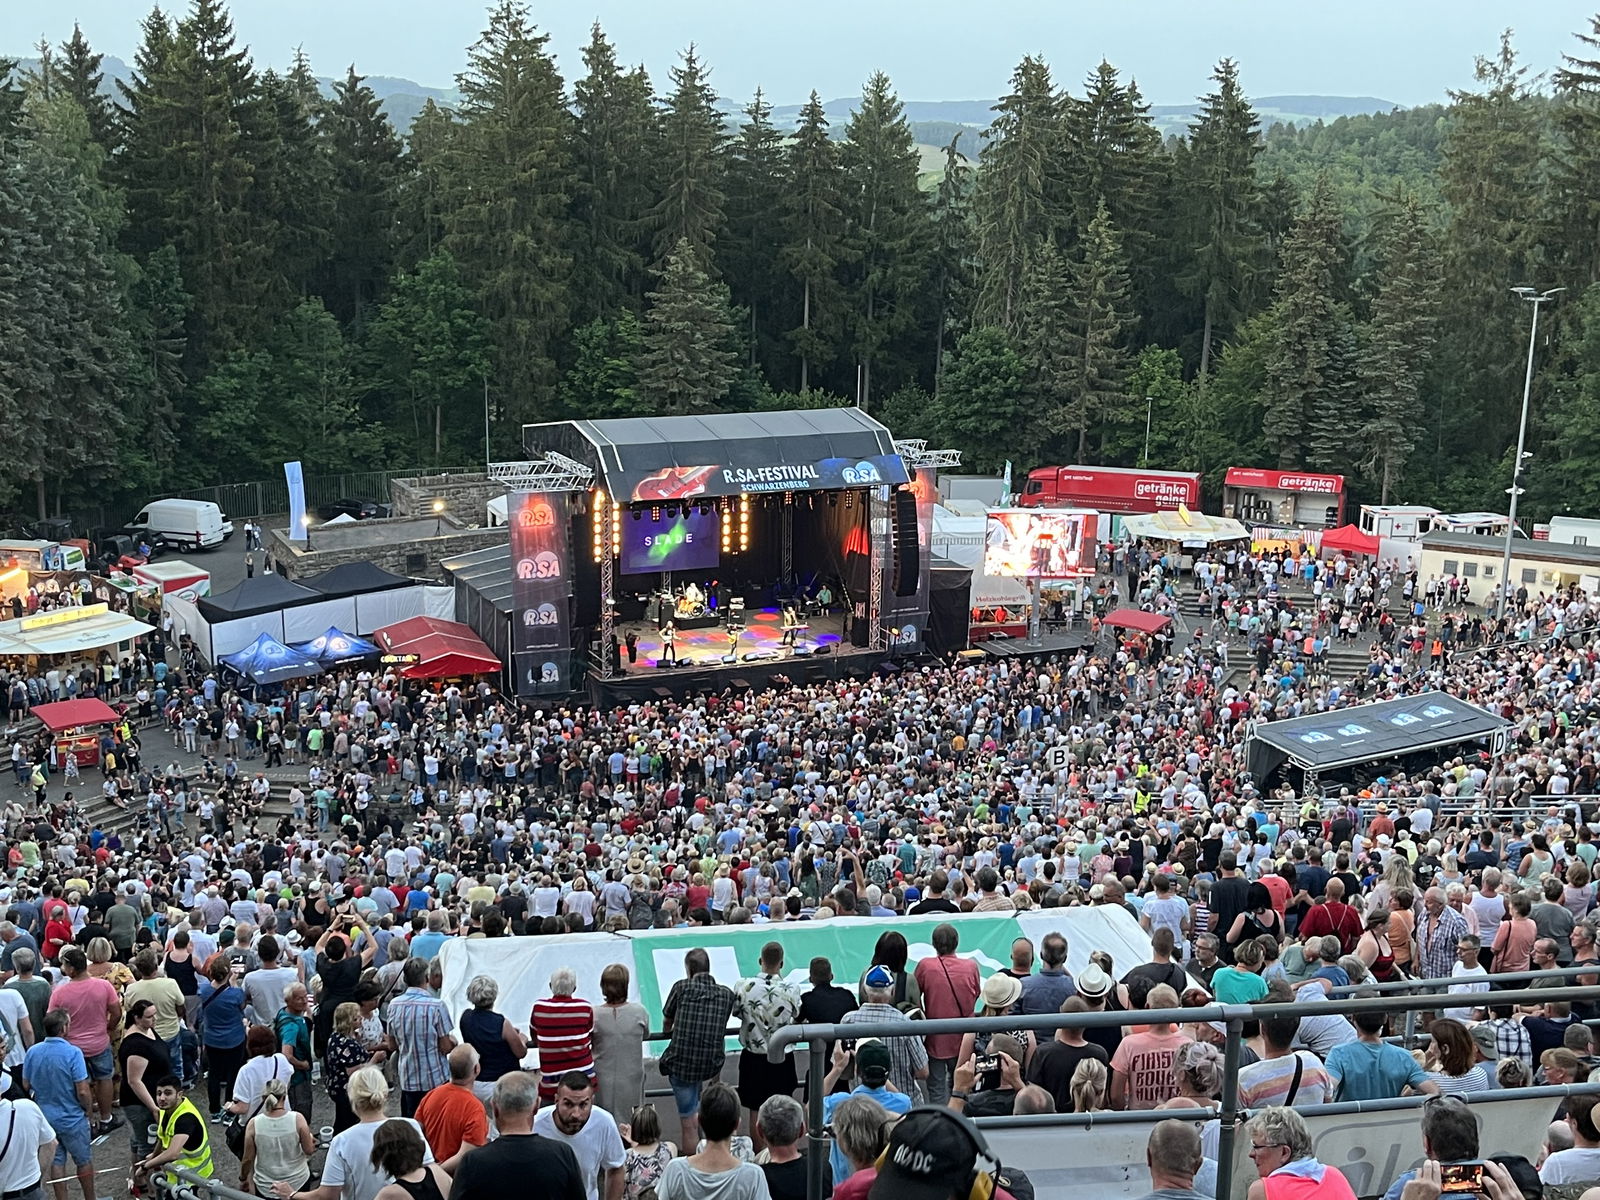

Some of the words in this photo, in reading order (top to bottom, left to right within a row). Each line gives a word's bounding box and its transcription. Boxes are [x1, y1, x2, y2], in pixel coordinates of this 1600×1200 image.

[722, 464, 819, 484] R.SA-FESTIVAL
[845, 467, 881, 483] R.SA
[740, 480, 810, 492] SCHWARZENBERG
[1137, 483, 1187, 495] getränke
[1281, 477, 1333, 488] getränke
[644, 533, 693, 546] SLADE
[518, 560, 560, 579] R.SA
[525, 610, 558, 626] R.SA
[1494, 731, 1504, 753] D
[1053, 749, 1065, 766] B
